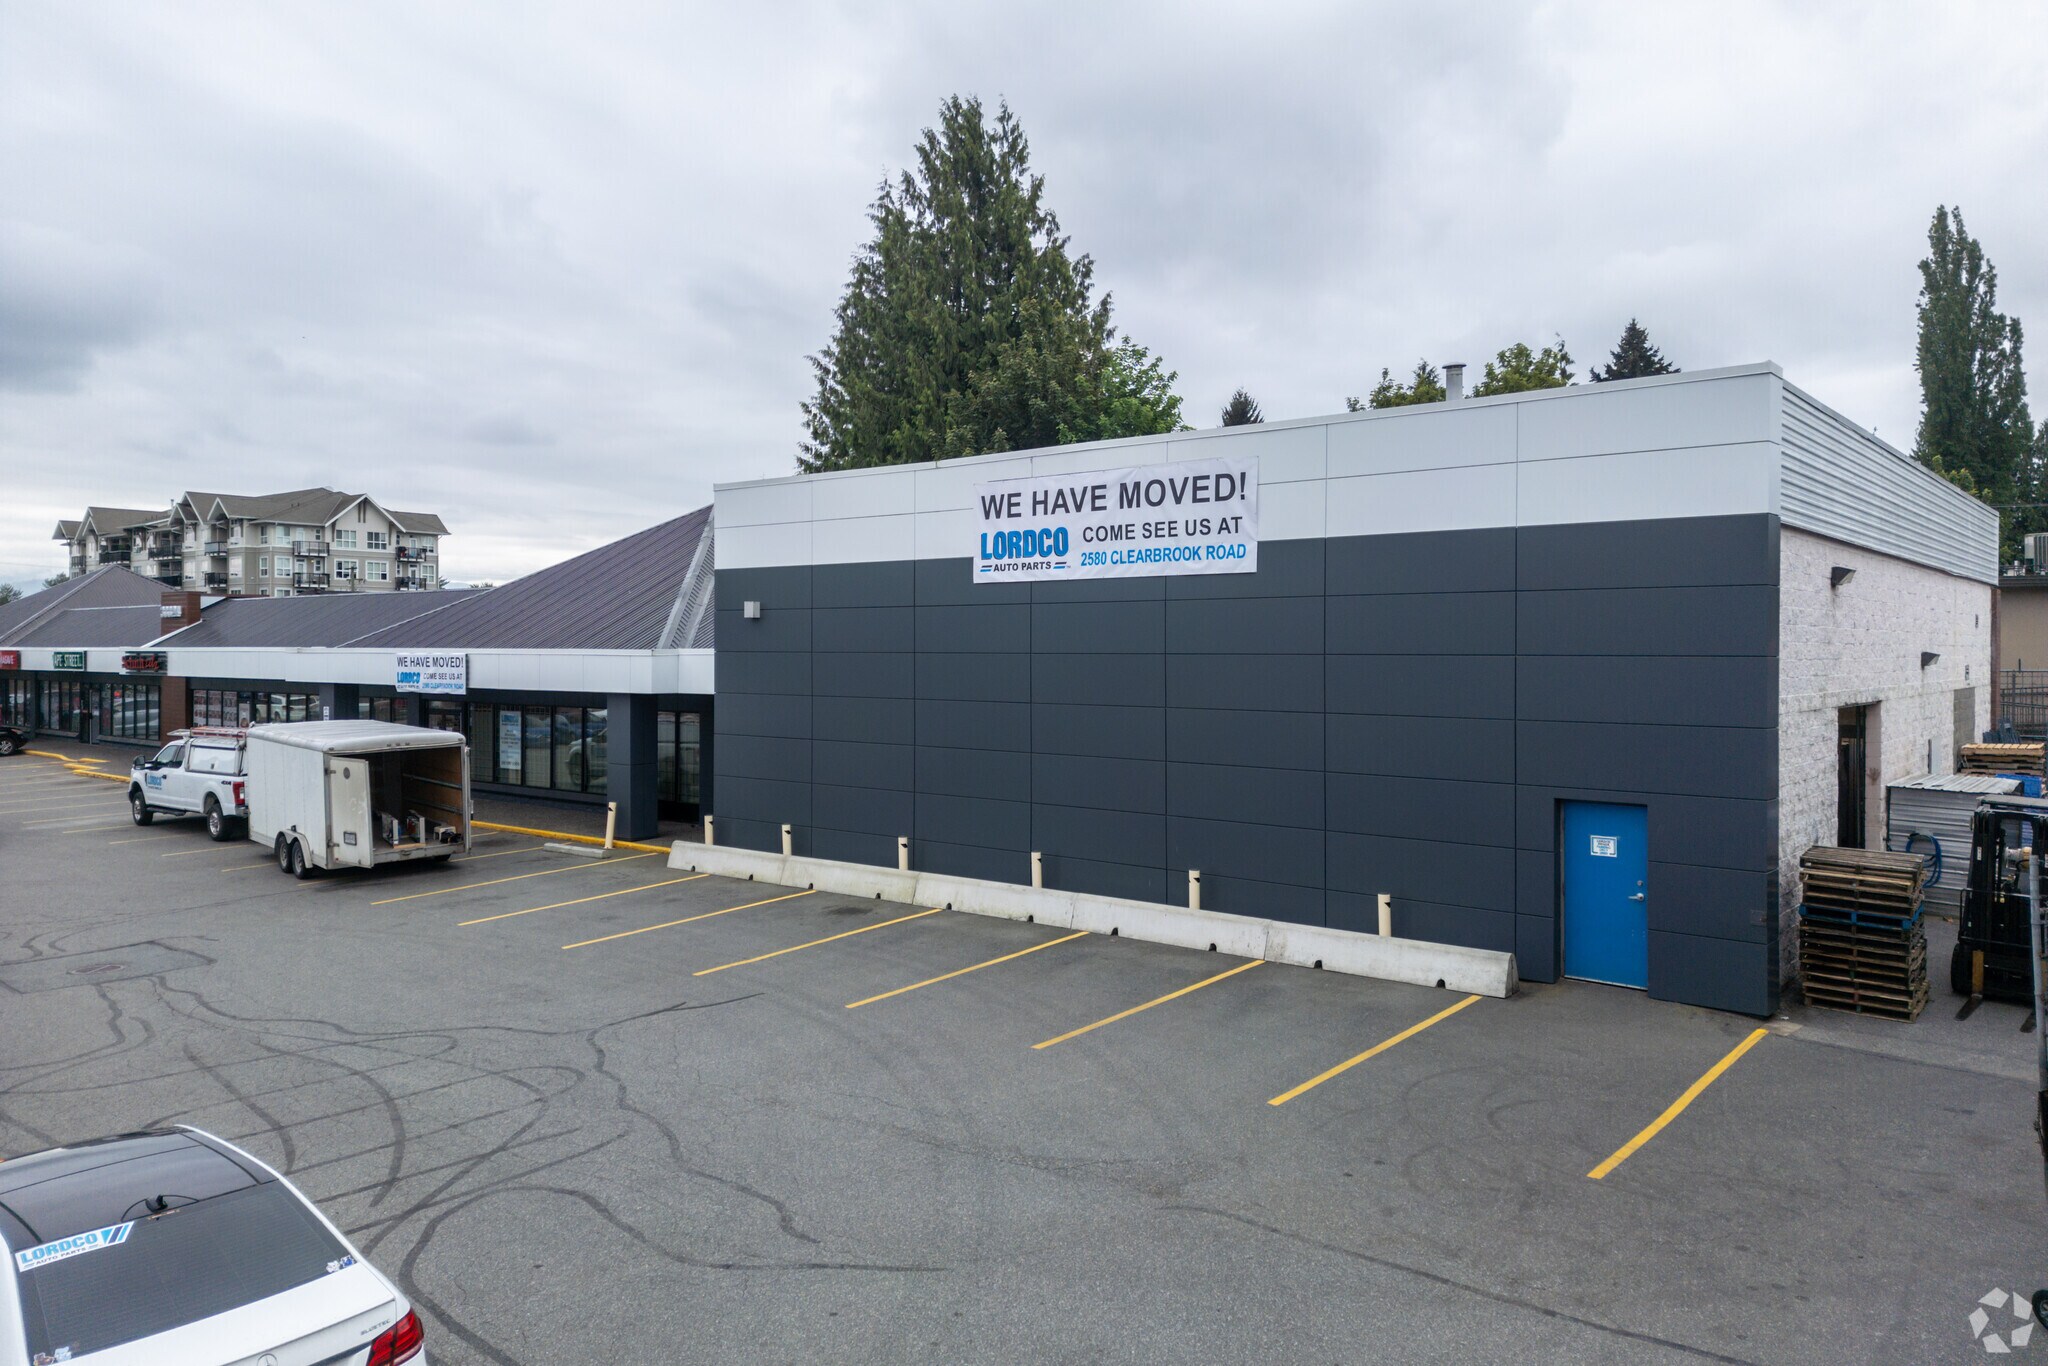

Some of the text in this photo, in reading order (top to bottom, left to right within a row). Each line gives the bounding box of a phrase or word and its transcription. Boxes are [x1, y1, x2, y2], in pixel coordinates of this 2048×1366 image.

[981, 472, 1247, 520] WE HAVE MOVED!
[1082, 516, 1243, 543] COME SEE US AT
[980, 526, 1069, 560] LORDCO
[1081, 543, 1246, 567] 2580 CLEARBROOK ROAD
[993, 560, 1052, 572] AUTO PARTS
[397, 657, 464, 668] WE HAVE MOVED!
[19, 1233, 98, 1264] LORDCO
[36, 1247, 86, 1265] AUTO PARTS
